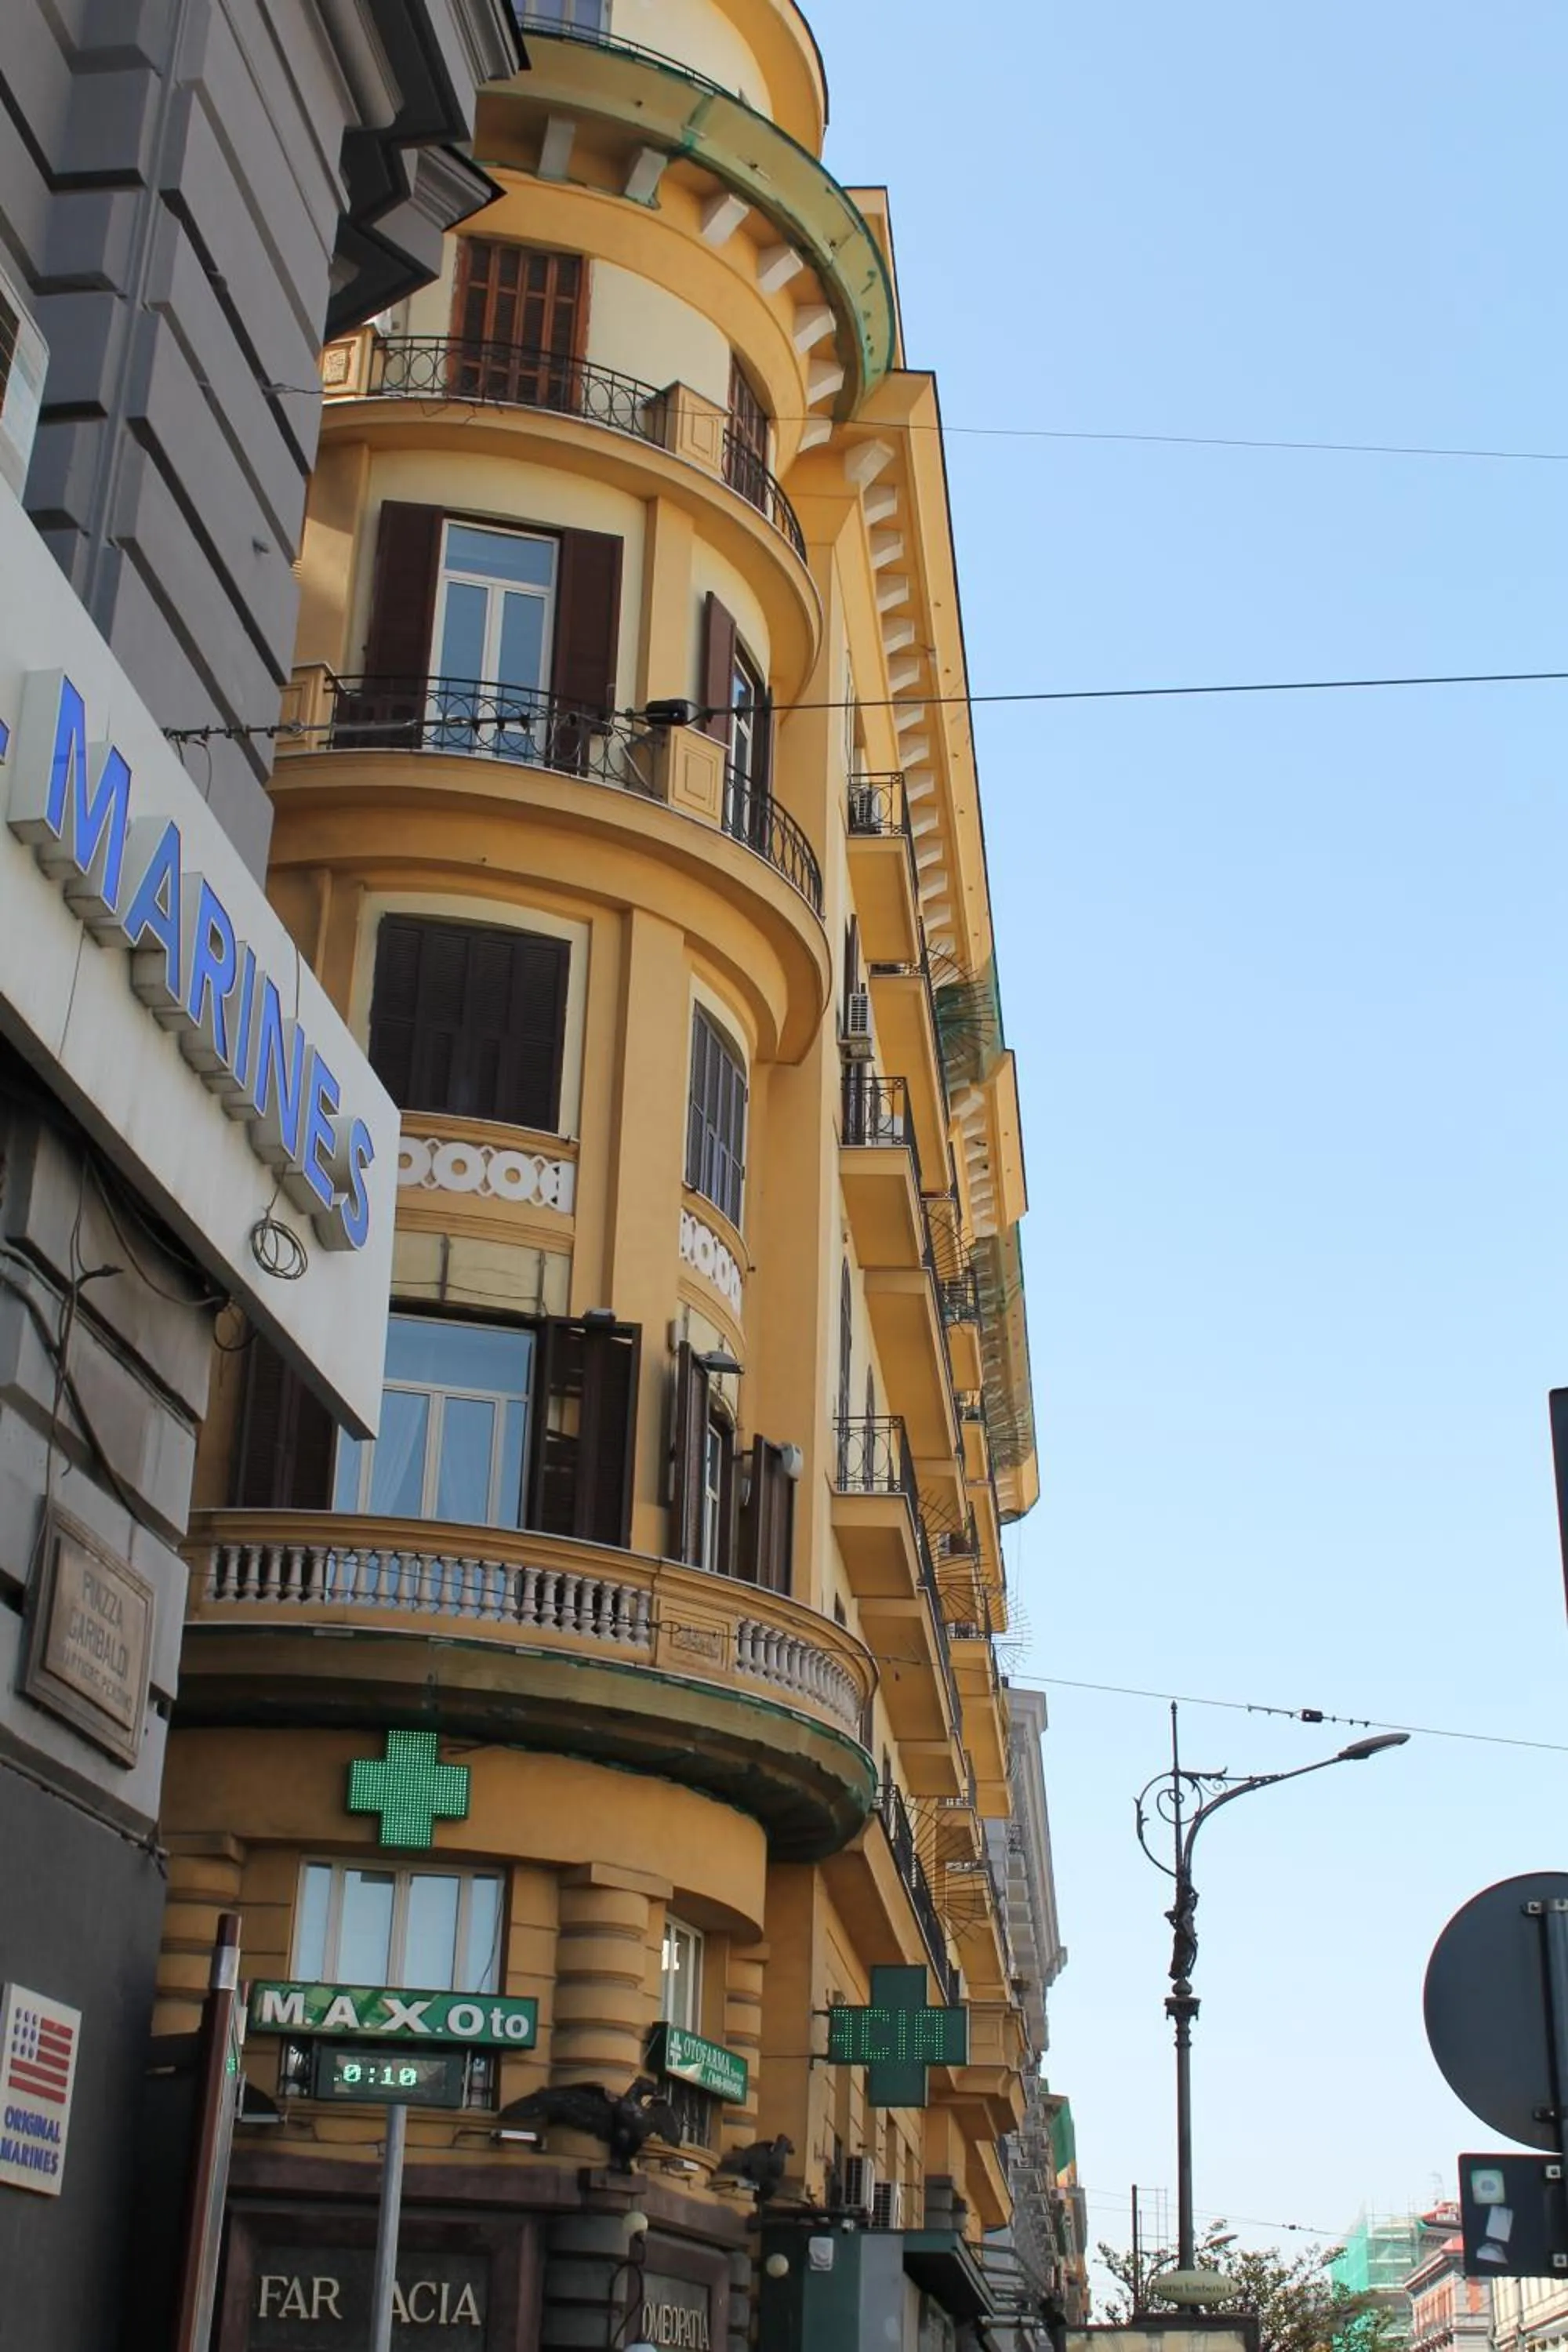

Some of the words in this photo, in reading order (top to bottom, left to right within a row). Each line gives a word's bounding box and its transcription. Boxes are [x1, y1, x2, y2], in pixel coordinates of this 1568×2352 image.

[46, 674, 376, 1252] MARINES
[82, 1570, 123, 1632] PIAZZA
[68, 1610, 129, 1682] GARIBALDI
[5, 2105, 60, 2143] ORIGINAL
[0, 2136, 59, 2176] MARINES
[257, 2275, 482, 2326] FARACIA
